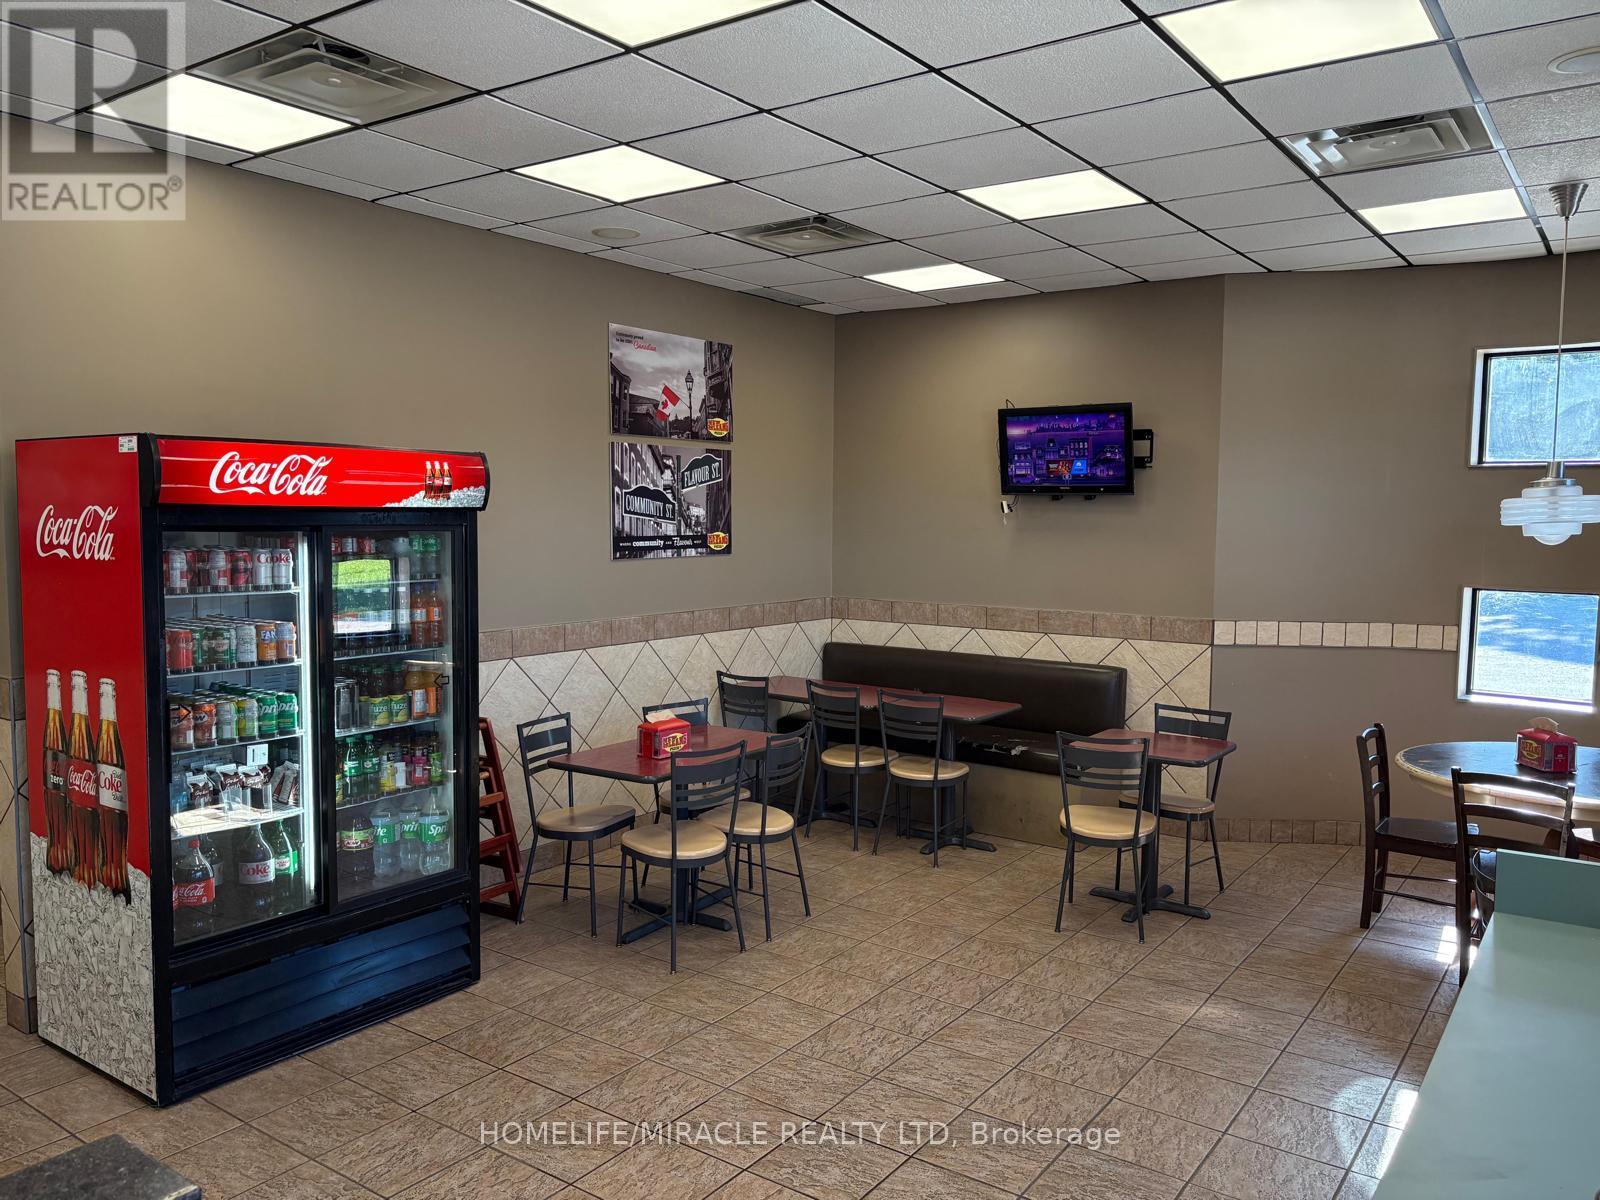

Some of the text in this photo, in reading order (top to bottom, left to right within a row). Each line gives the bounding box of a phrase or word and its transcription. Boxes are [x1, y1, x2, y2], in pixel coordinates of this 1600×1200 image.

[209, 451, 333, 495] Coca-Cola
[684, 462, 721, 487] FLAVOUR ST.
[626, 494, 664, 517] COMMUNITY
[36, 504, 118, 561] Coca-Cola
[632, 537, 664, 547] community
[261, 630, 276, 641] FAN
[50, 774, 64, 785] zero
[68, 765, 98, 796] Coca-Cola
[98, 770, 122, 793] Coke
[241, 863, 270, 876] Coke
